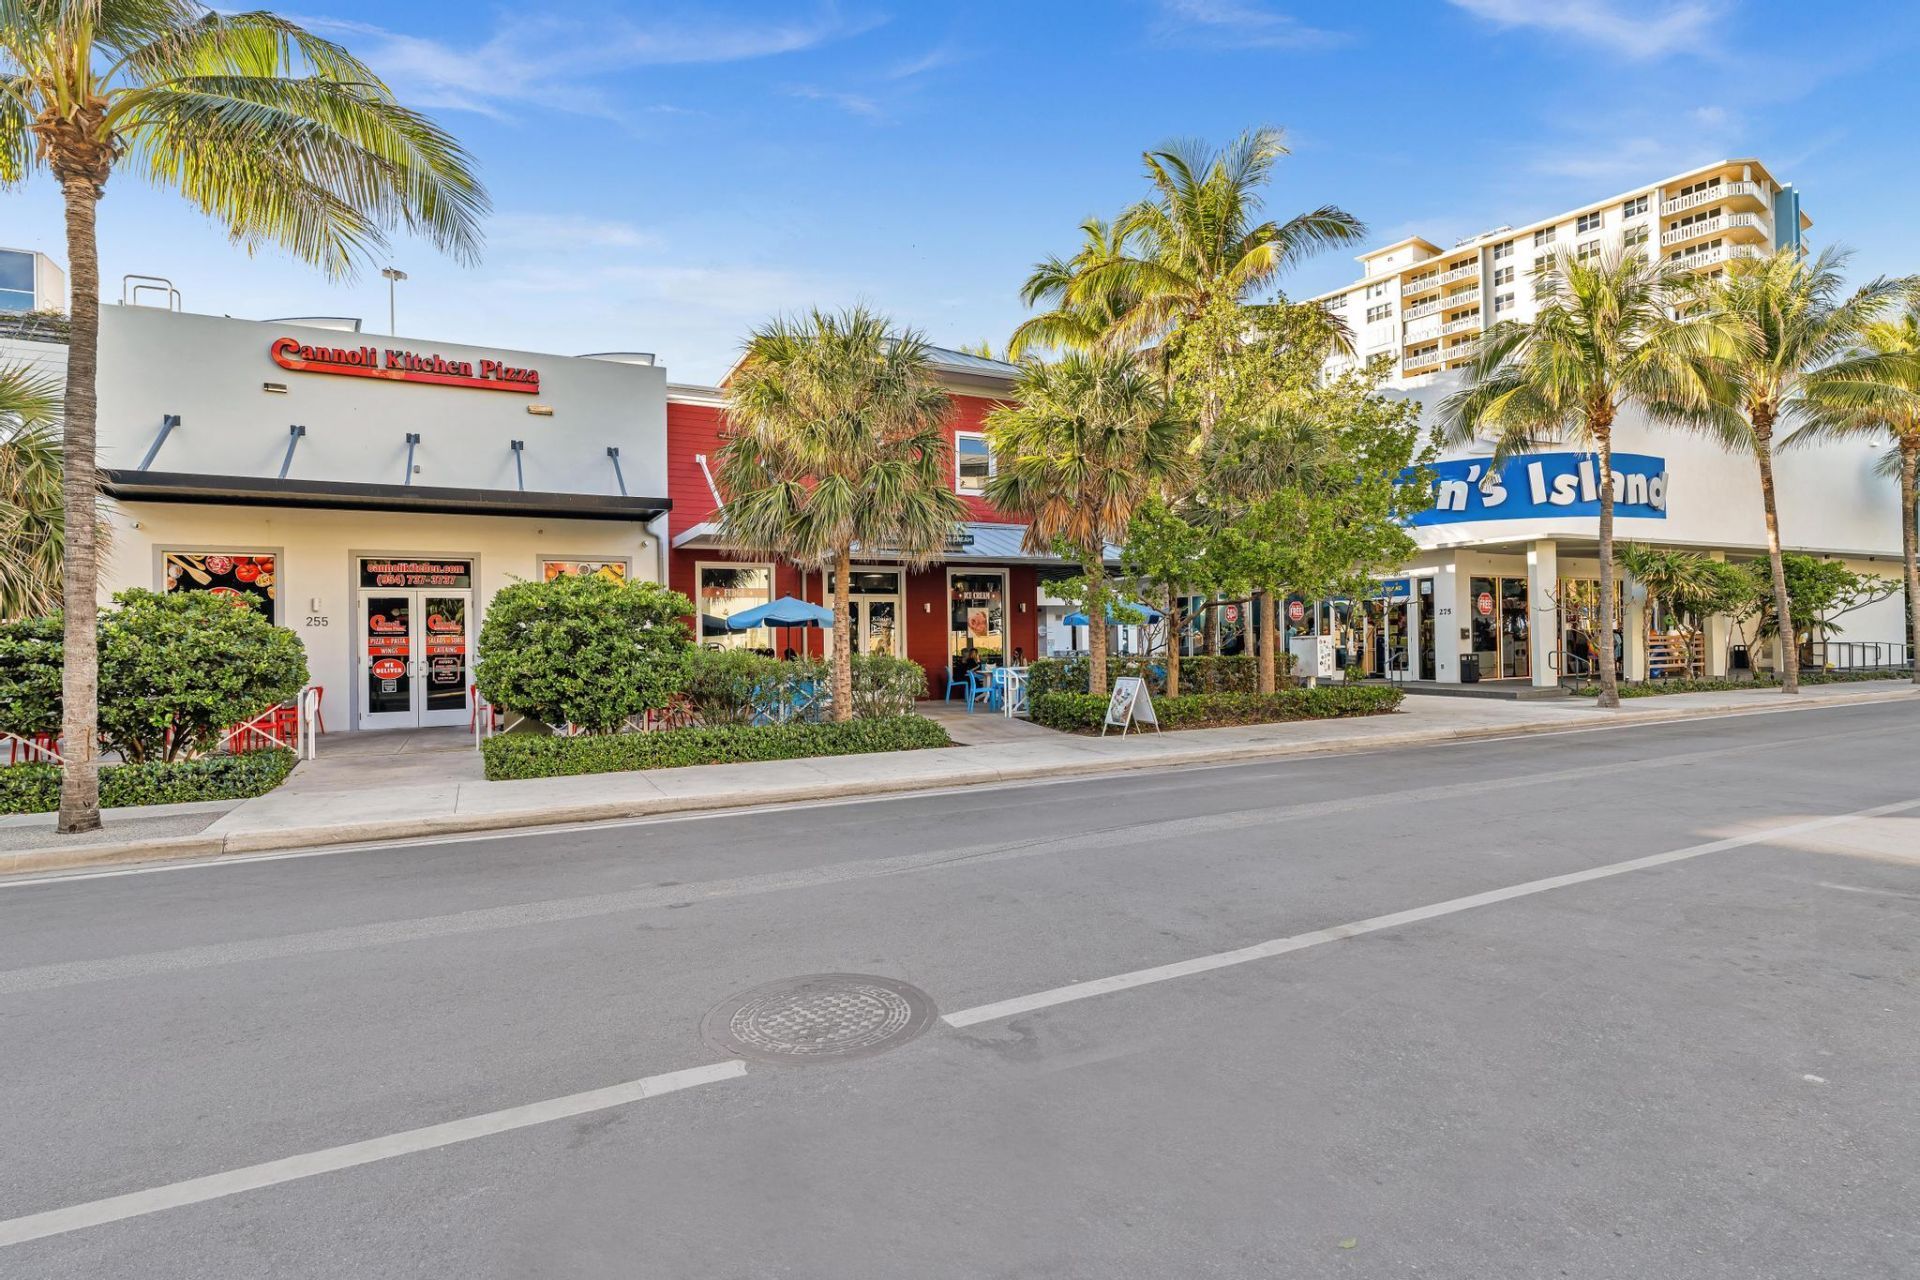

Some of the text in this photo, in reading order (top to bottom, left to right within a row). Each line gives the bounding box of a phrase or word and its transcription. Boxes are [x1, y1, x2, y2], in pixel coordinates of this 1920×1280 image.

[271, 337, 539, 384] Cannoli Kitchen Pizza
[964, 591, 990, 600] ICE CREAM
[306, 616, 329, 627] 255
